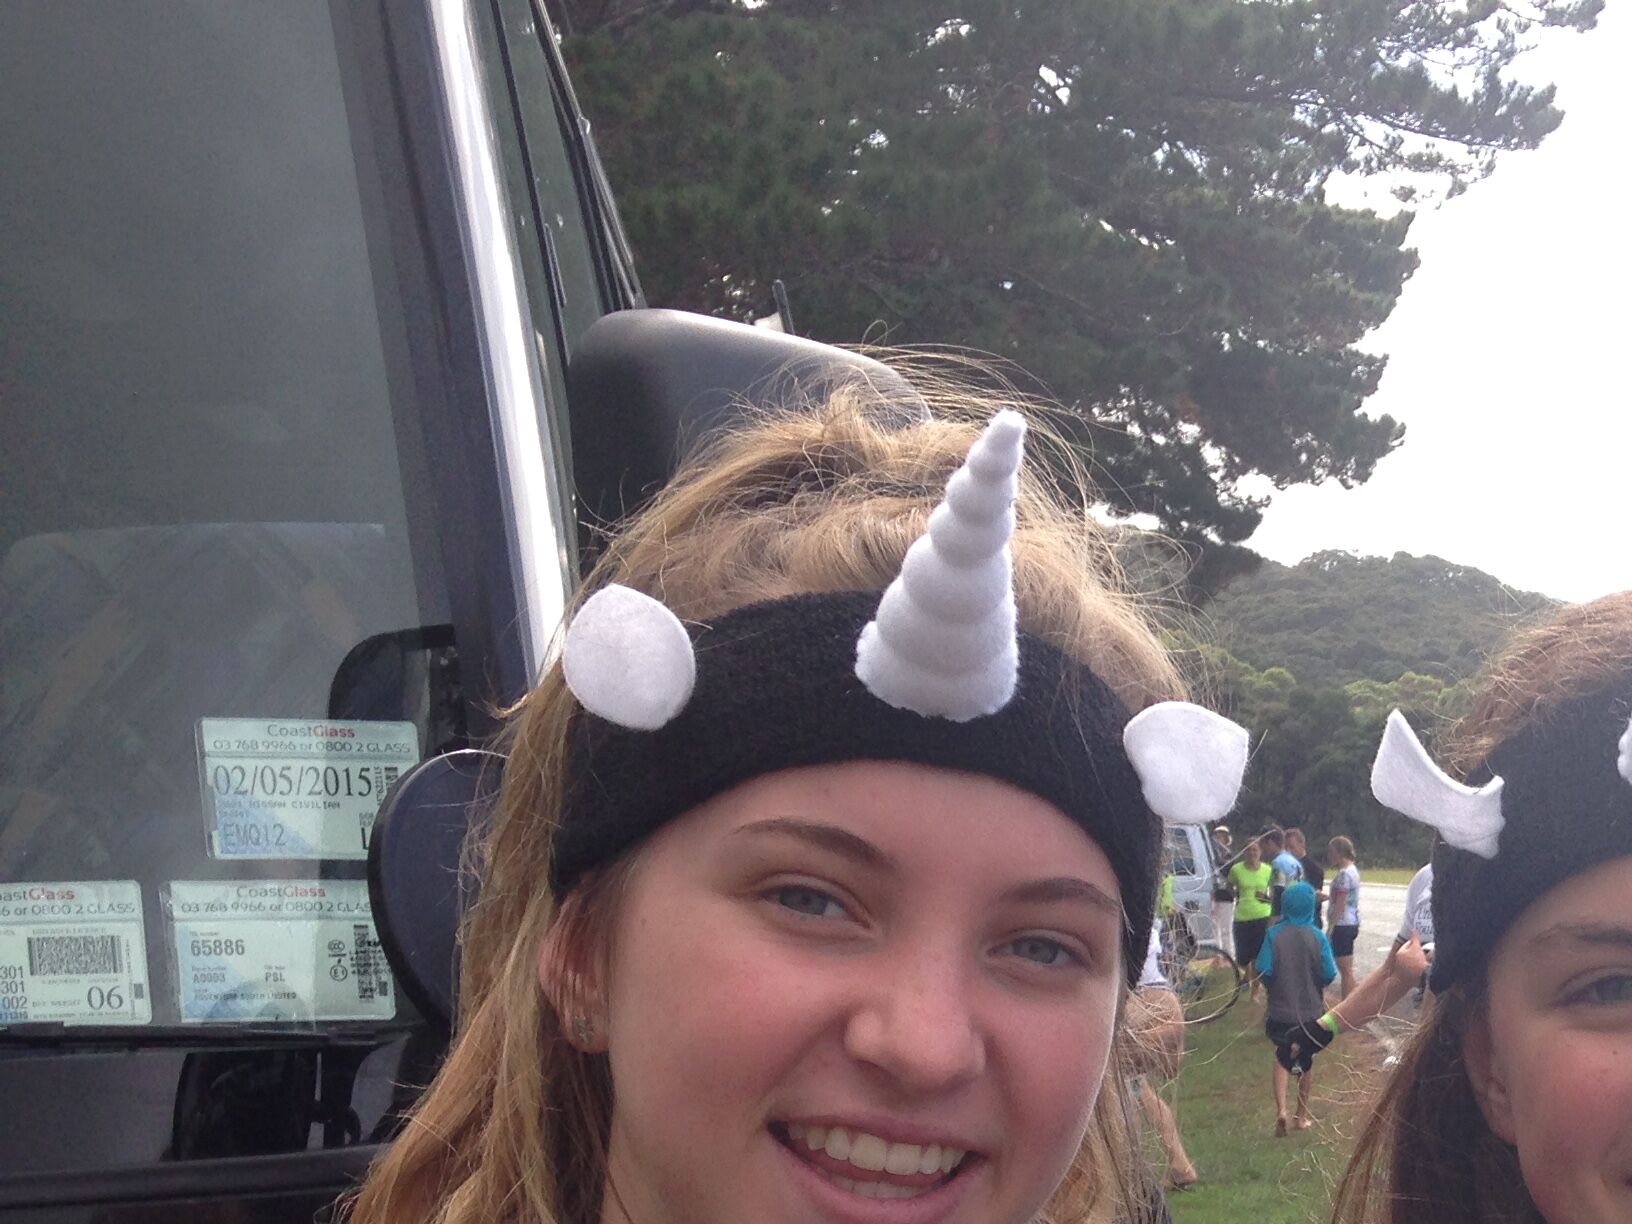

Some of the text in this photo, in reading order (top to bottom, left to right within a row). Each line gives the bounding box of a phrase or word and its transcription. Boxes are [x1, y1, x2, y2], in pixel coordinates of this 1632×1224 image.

[267, 724, 355, 738] CoastGlass
[213, 739, 231, 750] 03
[300, 742, 312, 750] or
[315, 741, 352, 751] 0800
[355, 742, 363, 752] 2
[366, 742, 410, 752] GLASS
[213, 765, 373, 797] 02/05/2015
[0, 888, 75, 900] astGlass
[237, 886, 326, 898] CoastGlass
[75, 905, 84, 914] 2
[87, 903, 135, 914] GLASS
[181, 902, 200, 913] 03
[325, 902, 333, 912] 2
[337, 902, 370, 912] GLAS
[191, 939, 245, 956] 65886
[87, 986, 124, 1010] 06
